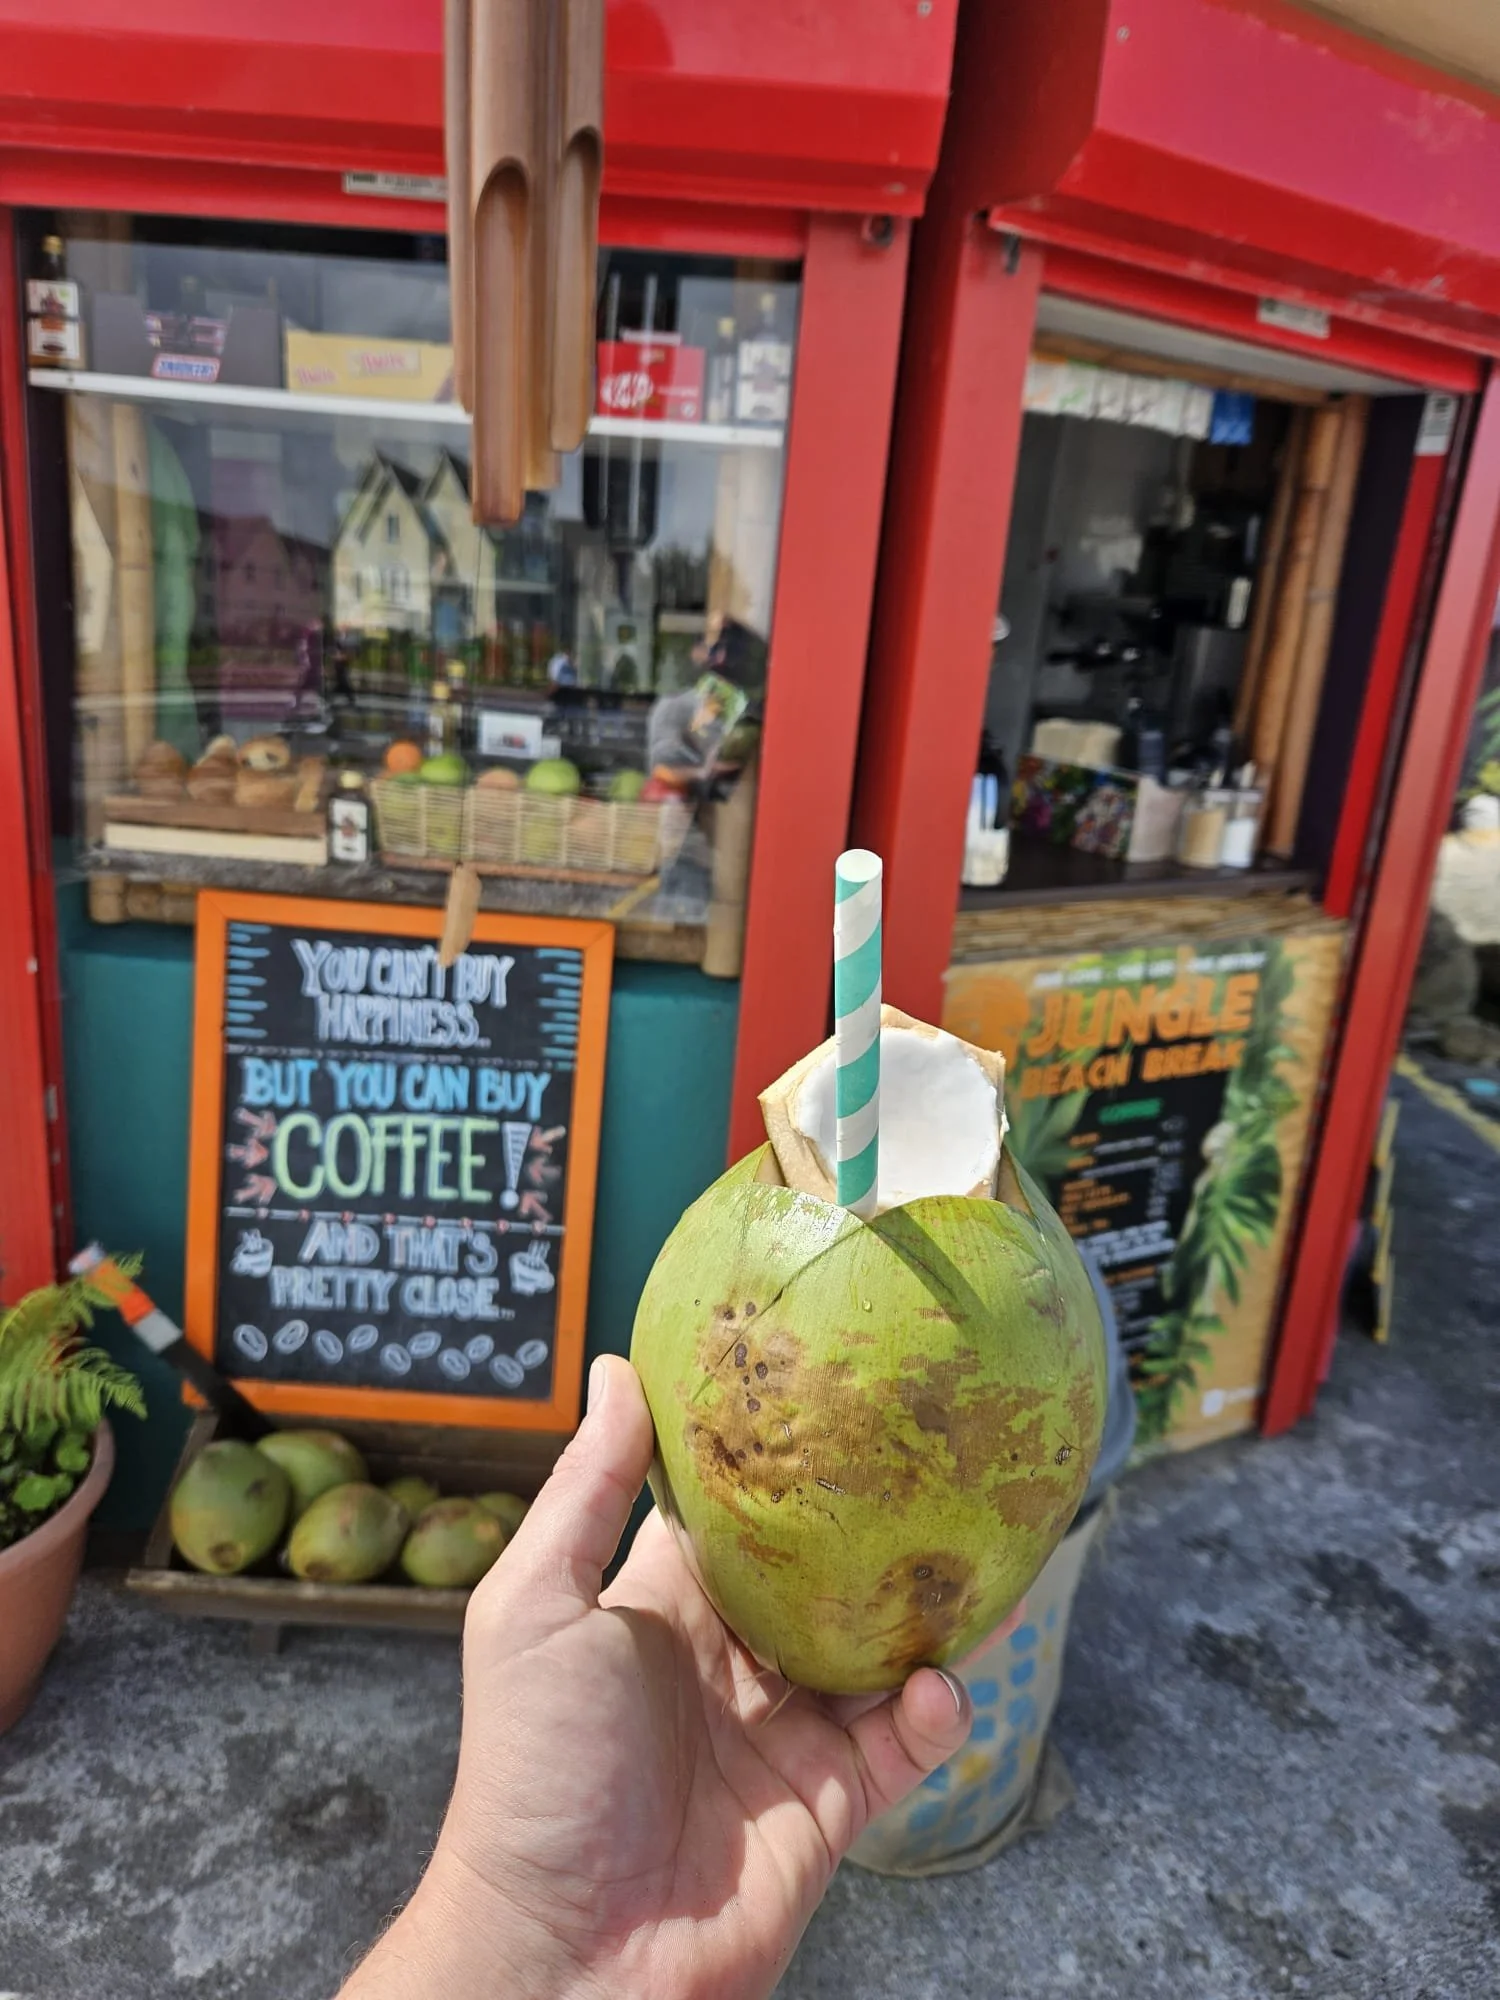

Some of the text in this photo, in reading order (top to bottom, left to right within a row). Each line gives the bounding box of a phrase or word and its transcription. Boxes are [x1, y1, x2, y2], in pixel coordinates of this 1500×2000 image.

[291, 938, 369, 998] YOU
[453, 953, 515, 1008] BUY
[1027, 972, 1260, 1059] JUNGLE
[242, 1057, 551, 1120] BUT YOU CAN BUY
[1020, 1037, 1246, 1099] BEACH BREAK
[298, 1220, 498, 1276] AND THAT'S
[269, 1265, 398, 1314] PRETTY
